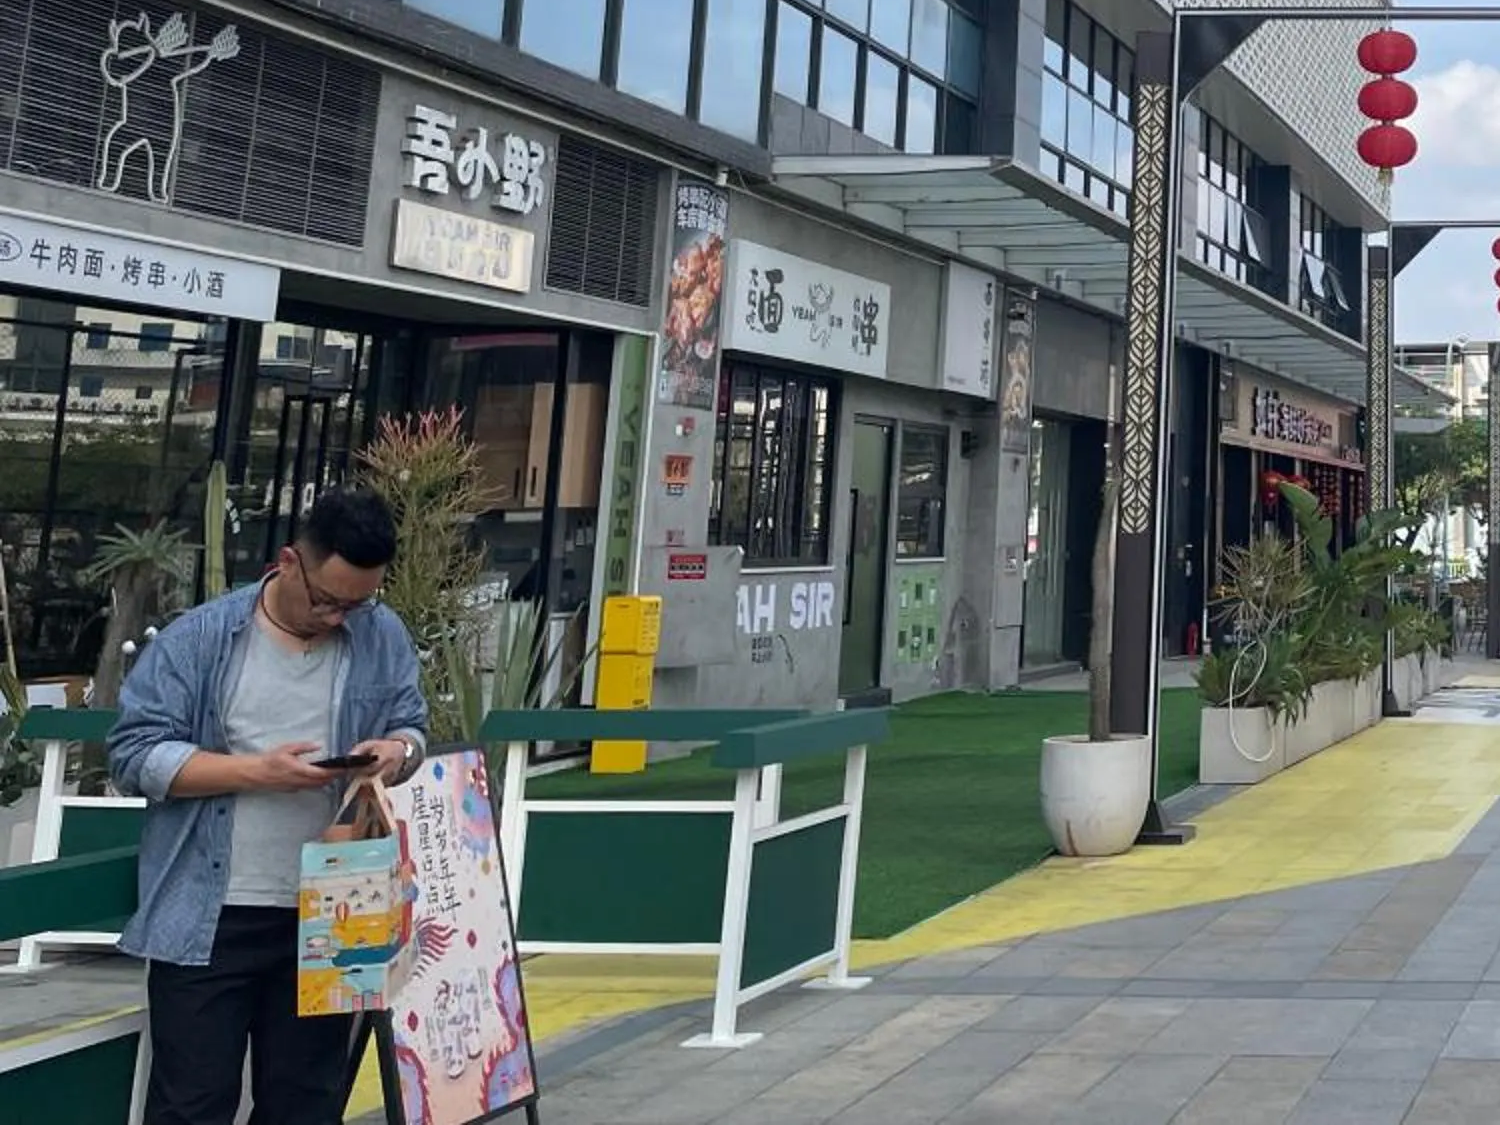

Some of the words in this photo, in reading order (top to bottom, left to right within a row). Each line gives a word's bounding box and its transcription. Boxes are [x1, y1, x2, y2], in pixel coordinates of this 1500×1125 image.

[404, 104, 545, 215] 吾小野
[790, 582, 835, 629] SIR
